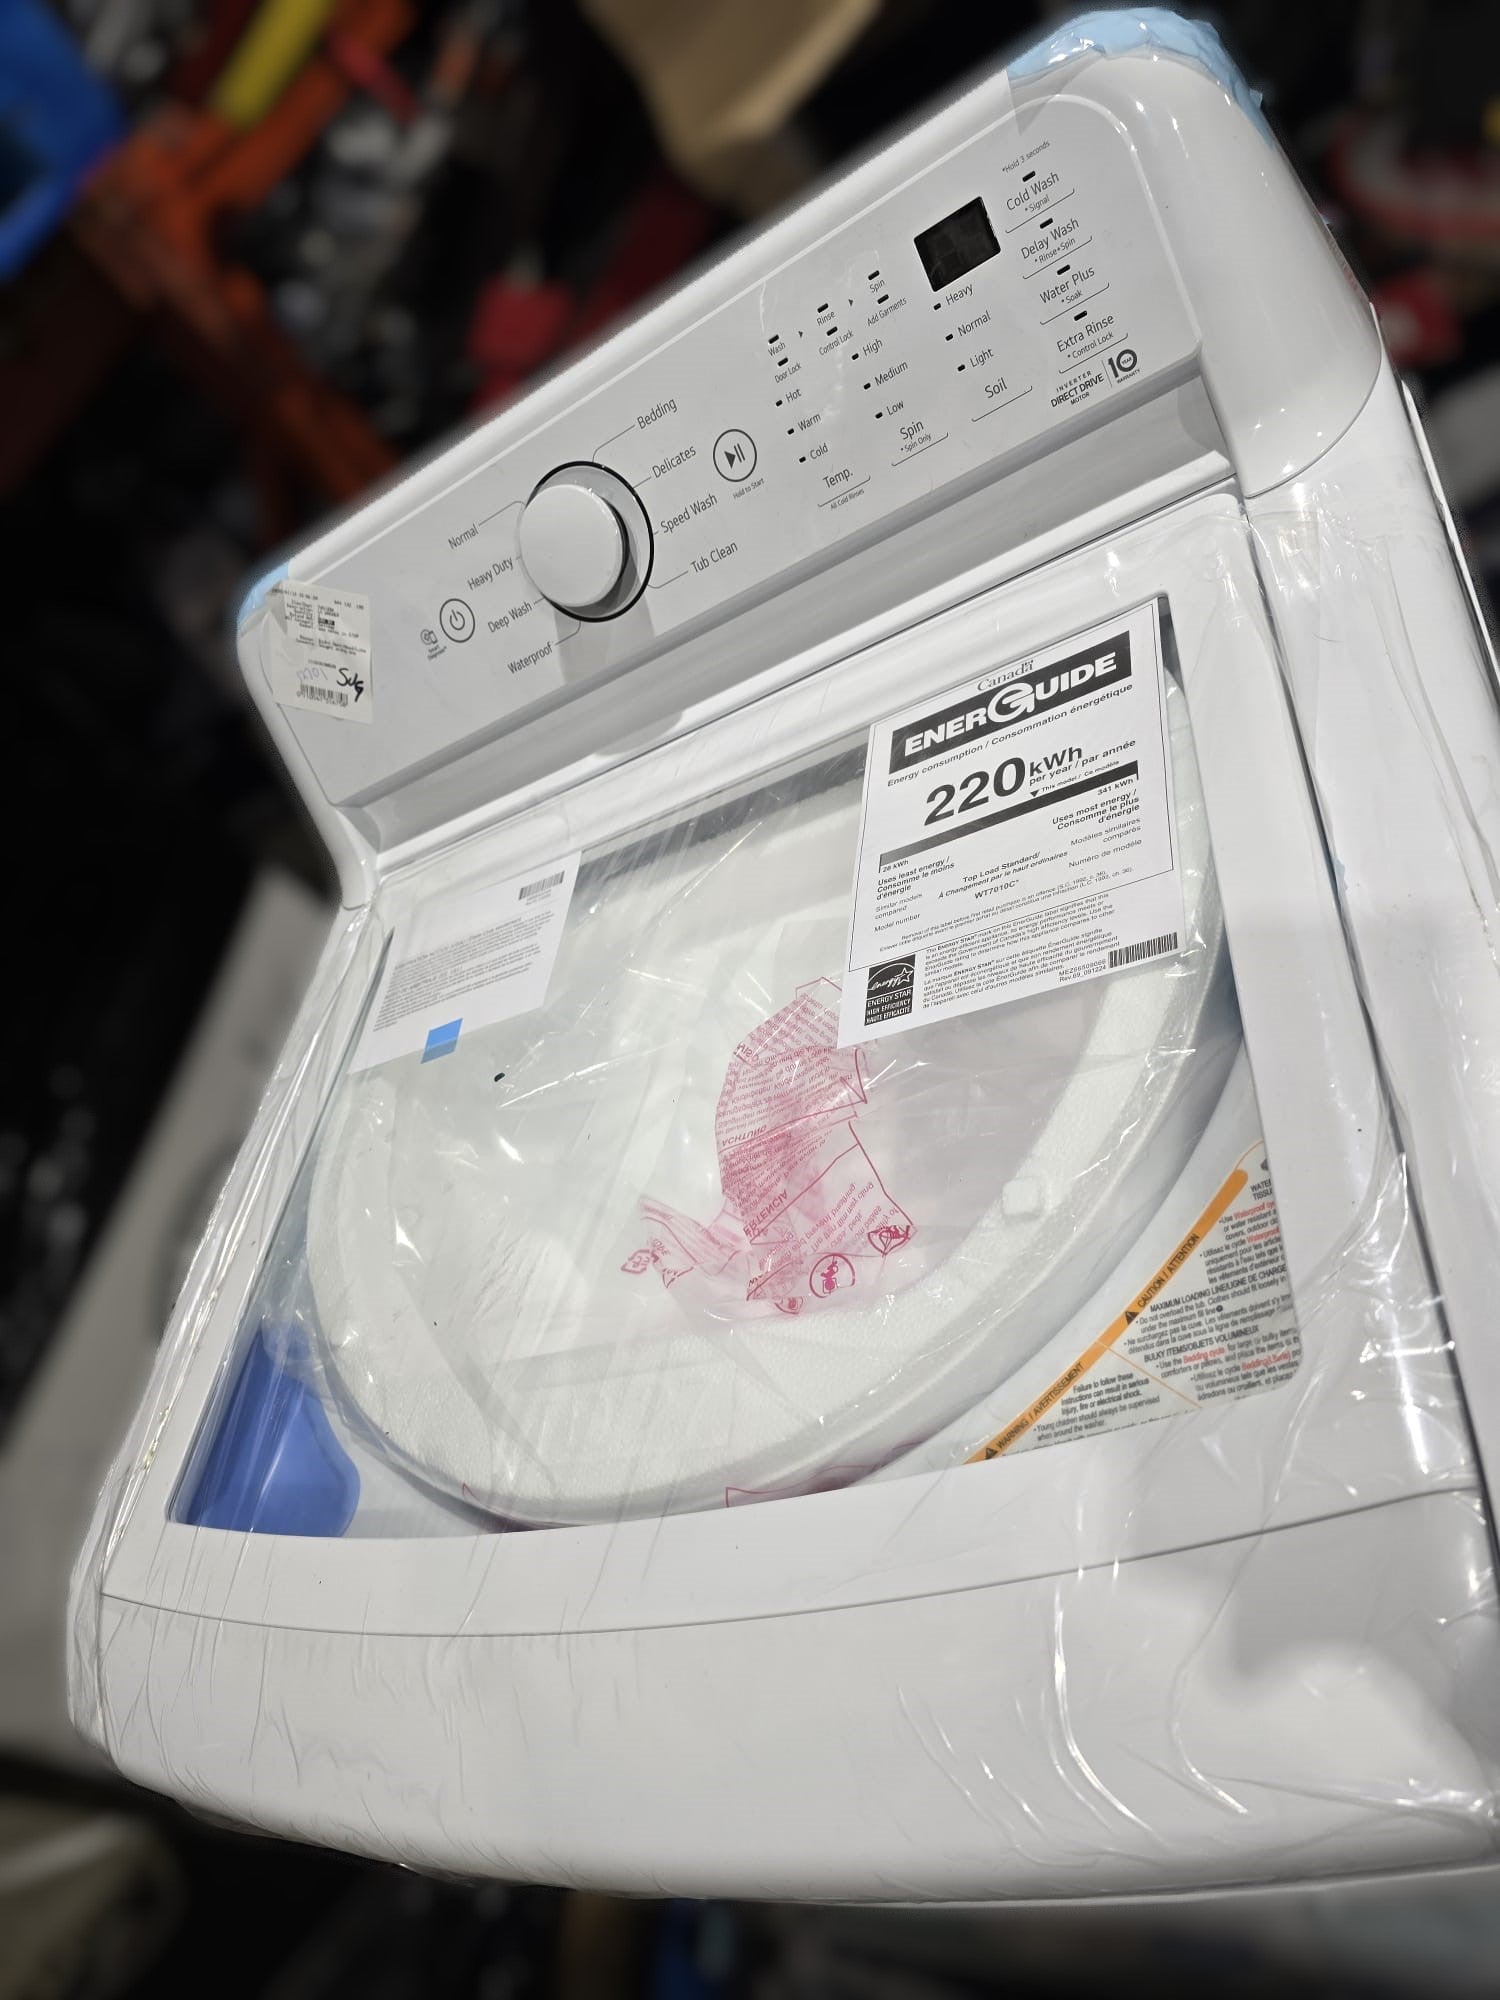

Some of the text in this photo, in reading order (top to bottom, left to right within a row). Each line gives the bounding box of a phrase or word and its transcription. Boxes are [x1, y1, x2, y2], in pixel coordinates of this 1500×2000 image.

[1020, 155, 1025, 163] 3
[1026, 140, 1050, 160] seconds
[1006, 172, 1059, 211] Cold Wash
[1021, 218, 1079, 259] Delay Wash
[869, 279, 885, 293] Spin
[945, 284, 973, 306] Heavy
[1039, 267, 1095, 303] Water Plus
[816, 311, 836, 326] Rinse
[867, 297, 907, 326] Add Garments
[957, 310, 991, 337] Normal
[819, 329, 854, 356] Control Lock
[1057, 315, 1114, 352] Extra Rinse
[1097, 332, 1114, 345] Lock
[768, 342, 786, 356] Wash
[862, 338, 883, 357] High
[969, 349, 994, 368] Light
[774, 362, 802, 384] Door Lock
[1106, 347, 1138, 378] 10
[1122, 357, 1132, 365] YEAR
[874, 362, 908, 386] Medium
[1056, 370, 1092, 393] INVERTER
[1117, 368, 1140, 384] WARRANTY
[785, 389, 802, 403] Hot
[985, 377, 1007, 399] Soil
[1051, 373, 1104, 407] DIRECT DRIVE
[1070, 392, 1090, 405] MOTOR
[637, 399, 677, 429] Bedding
[886, 401, 904, 416] Low
[798, 414, 821, 431] Warm
[900, 421, 924, 440] Spin
[810, 442, 828, 460] Cold
[917, 433, 931, 445] Only
[652, 446, 696, 478] Delicates
[733, 488, 745, 499] Hold
[751, 478, 764, 489] Start
[822, 468, 853, 488] Temp.
[660, 493, 718, 533] Speed Wash
[837, 495, 849, 506] Cold
[448, 523, 479, 550] Normal
[690, 542, 738, 573] Tub Clean
[467, 557, 513, 590] Heavy Duty
[487, 601, 532, 633] Deep Wash
[507, 641, 552, 674] Waterproof
[977, 659, 1034, 691] Canada
[887, 770, 919, 787] Energy
[922, 745, 983, 773] consumption
[992, 711, 1067, 745] Consommation
[1070, 684, 1133, 714] énergétique
[1030, 774, 1046, 787] per
[1050, 764, 1072, 779] year
[1082, 754, 1099, 767] par
[1102, 740, 1136, 758] année
[924, 747, 1082, 826] 220 kWh
[1042, 784, 1055, 792] This
[1057, 776, 1077, 786] model
[1095, 761, 1119, 773] modèle
[1098, 779, 1133, 795] 341 kWh
[1052, 813, 1074, 825] Uses
[1077, 803, 1098, 816] most
[1100, 792, 1131, 807] energy
[1057, 809, 1107, 830] Consomme
[1120, 797, 1139, 810] plus
[1098, 805, 1140, 823] d'énergie
[1071, 818, 1140, 846] Modèles similaires
[1103, 826, 1141, 843] comparés
[893, 860, 908, 868] kWh
[1069, 854, 1099, 868] Numéro
[1113, 839, 1142, 853] modèle
[877, 875, 920, 893] Consomme
[931, 863, 955, 875] moins
[878, 876, 897, 886] Uses
[898, 868, 917, 879] least
[919, 859, 945, 872] energy
[963, 851, 1040, 883] Top Load Standard/
[990, 873, 1003, 882] par
[1031, 852, 1068, 868] ordinaires
[876, 885, 911, 901] d'énergie
[876, 894, 923, 912] Similar models
[874, 914, 920, 932] Model number
[875, 905, 907, 919] compared
[867, 988, 911, 1007] ENERGY STAR
[1137, 1275, 1166, 1309] CAUTION
[1166, 1233, 1200, 1274] ATTENTION
[1150, 1264, 1287, 1312] MAXIMUM LOADING LINE/LIGNE DE CHARGE
[1144, 1350, 1165, 1362] BULKY
[1215, 1325, 1259, 1343] VOLUMINEUX
[1073, 1384, 1092, 1393] Failure
[1100, 1377, 1116, 1386] follow
[1117, 1373, 1134, 1382] these
[996, 1419, 1030, 1448] WARNING
[1033, 1362, 1084, 1418] AVERTISSEMENT
